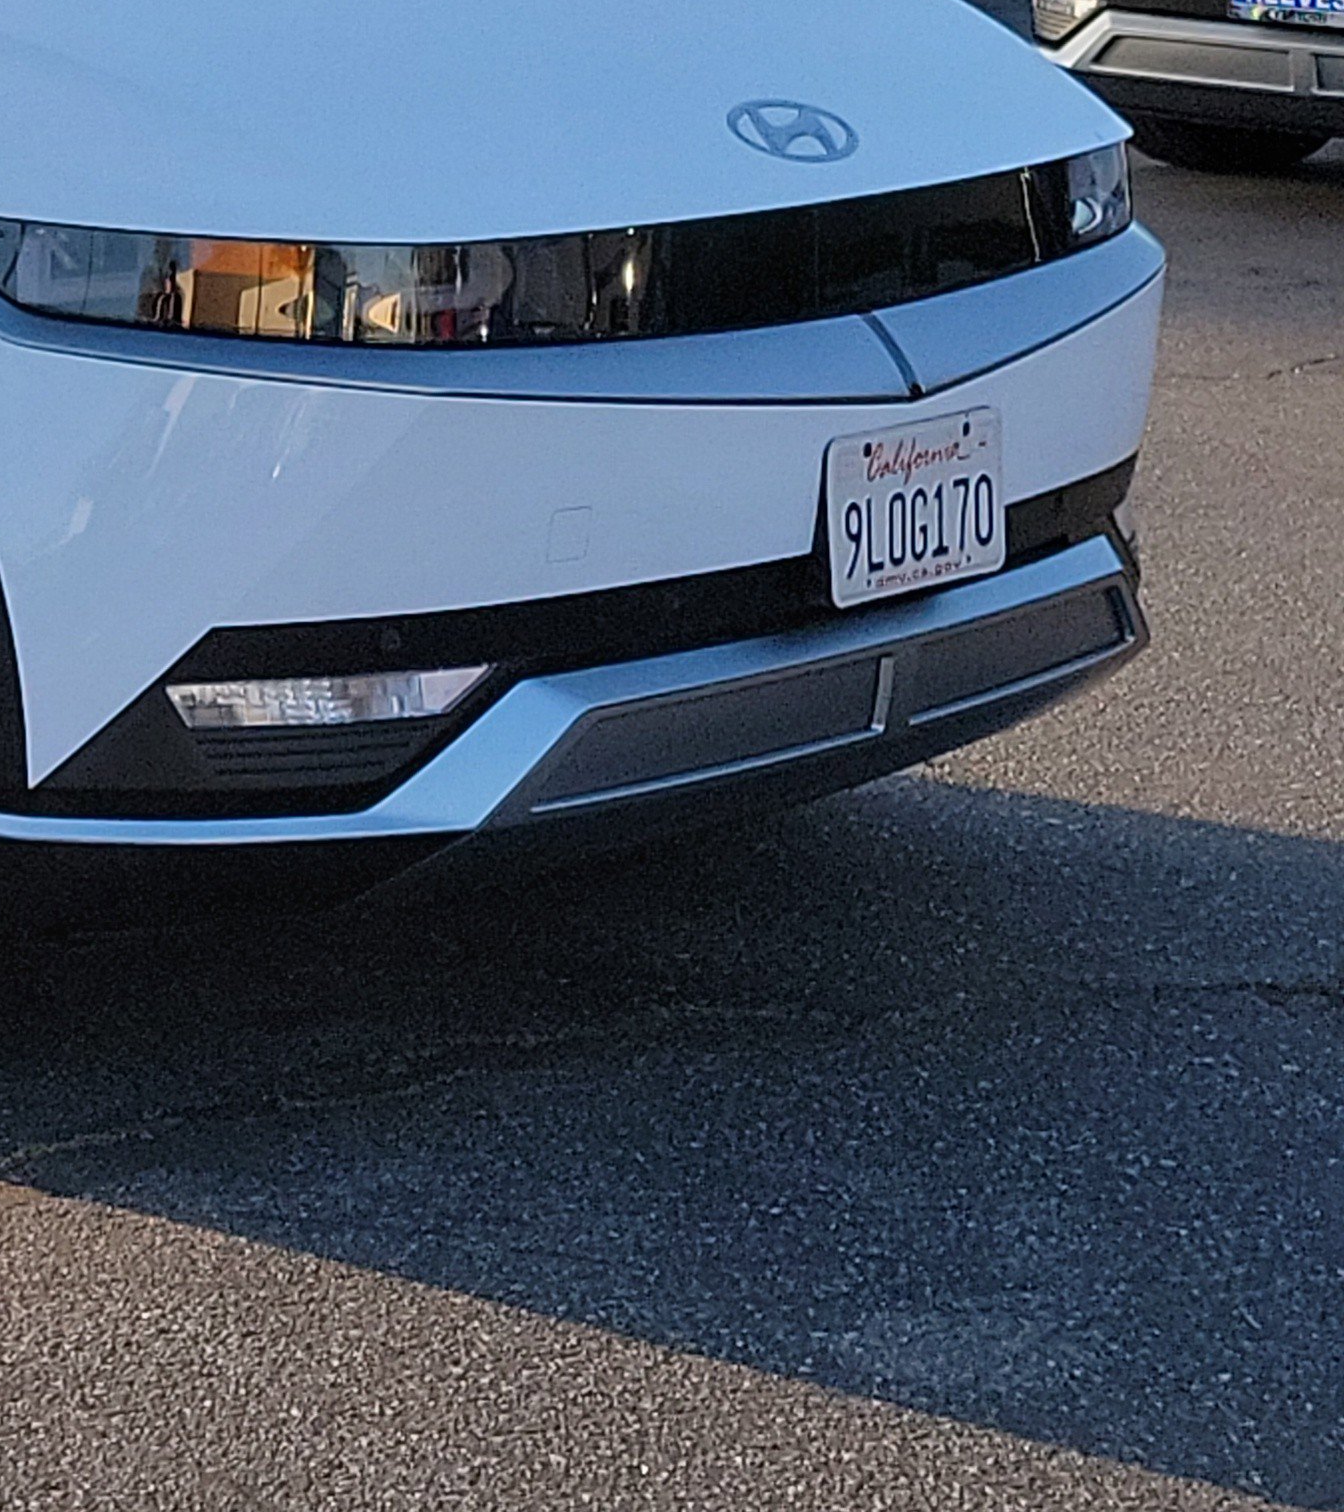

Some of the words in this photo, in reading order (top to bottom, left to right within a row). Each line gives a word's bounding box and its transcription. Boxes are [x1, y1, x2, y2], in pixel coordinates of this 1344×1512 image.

[867, 437, 964, 486] California
[845, 473, 994, 580] 9LOG170
[875, 561, 962, 588] dmv.ca.gov
